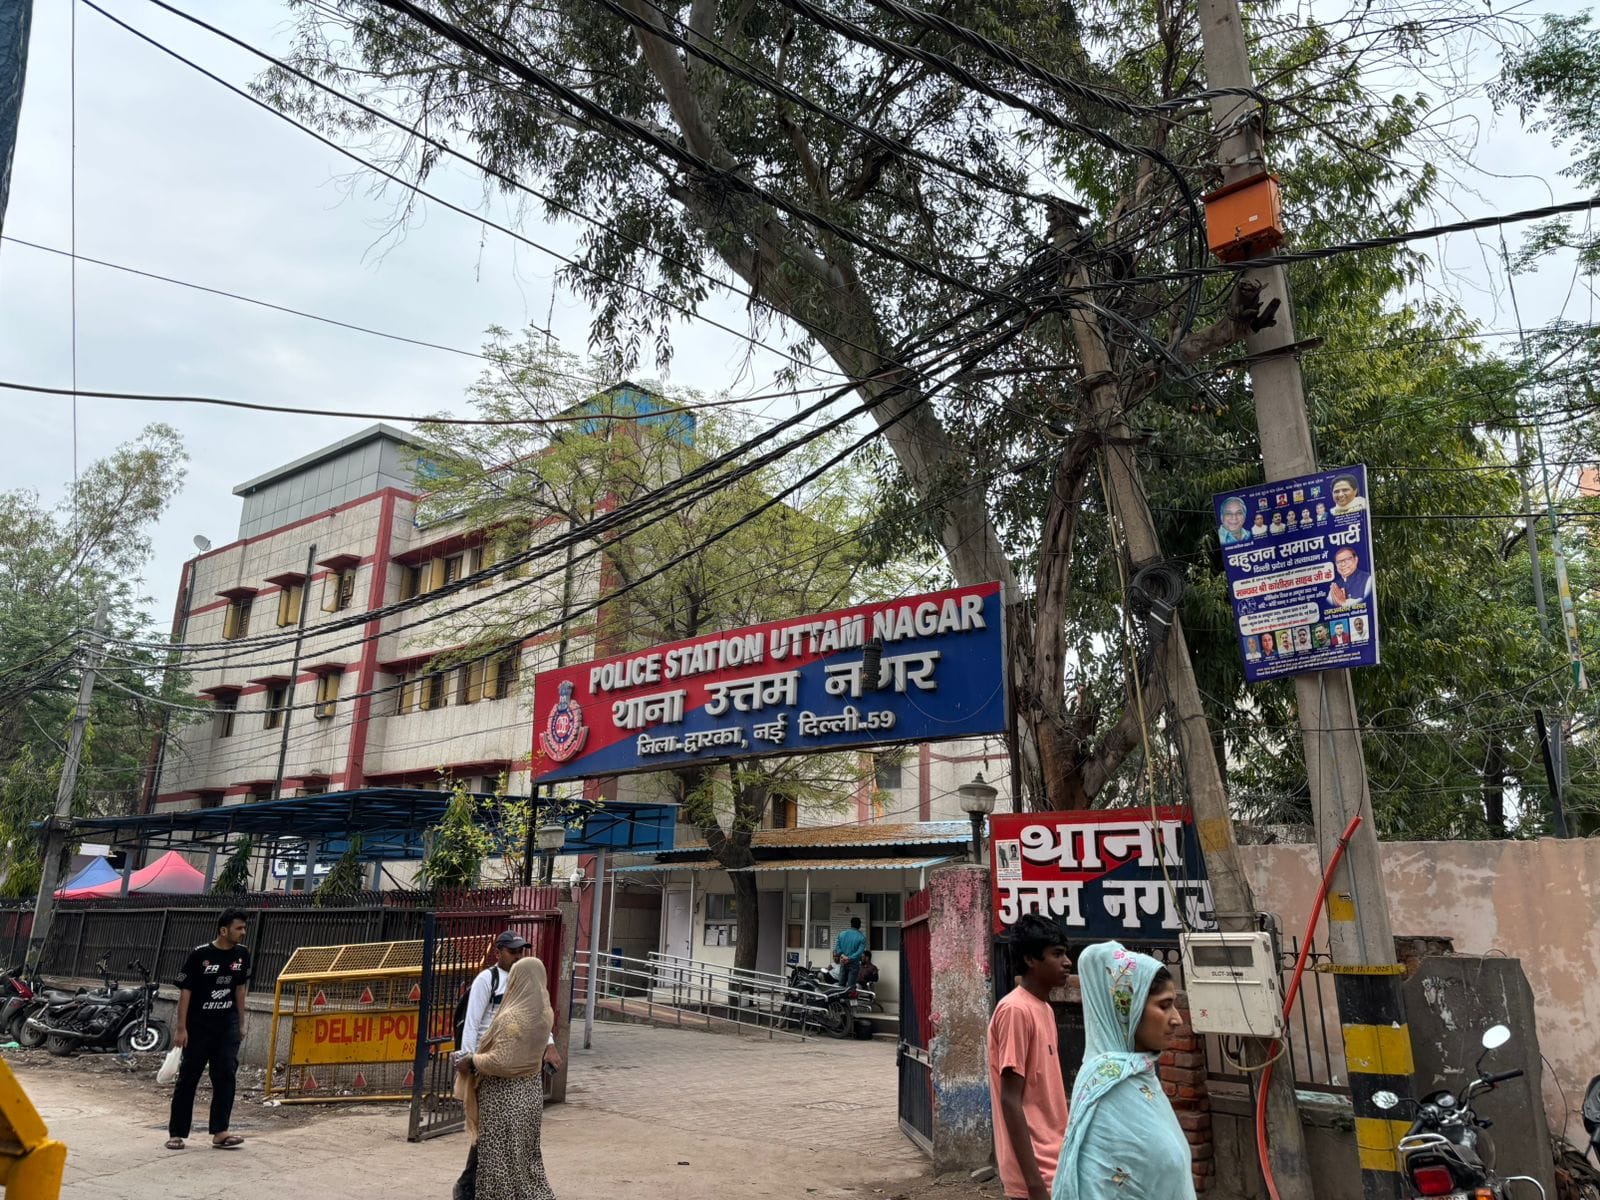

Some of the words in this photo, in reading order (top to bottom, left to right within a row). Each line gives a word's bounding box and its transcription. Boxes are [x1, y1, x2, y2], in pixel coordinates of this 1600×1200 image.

[1227, 545, 1276, 573] बहुजन
[1279, 535, 1325, 557] समाज
[1328, 523, 1361, 546] पार्टी
[589, 653, 661, 694] POLICE
[665, 632, 764, 679] STATION
[770, 614, 865, 660] UTTAM
[873, 594, 986, 642] NAGAR
[612, 689, 687, 729] थाना
[704, 670, 801, 716] उत्तम
[824, 651, 941, 697] नगर
[636, 726, 748, 756] जिला-द्वारका,
[753, 713, 788, 744] नई
[798, 705, 896, 736] दिल्ली-59
[1020, 820, 1184, 869] थाना
[996, 880, 1085, 926] उत्तम
[1102, 880, 1220, 931] नगर
[314, 1017, 373, 1044] DELHI
